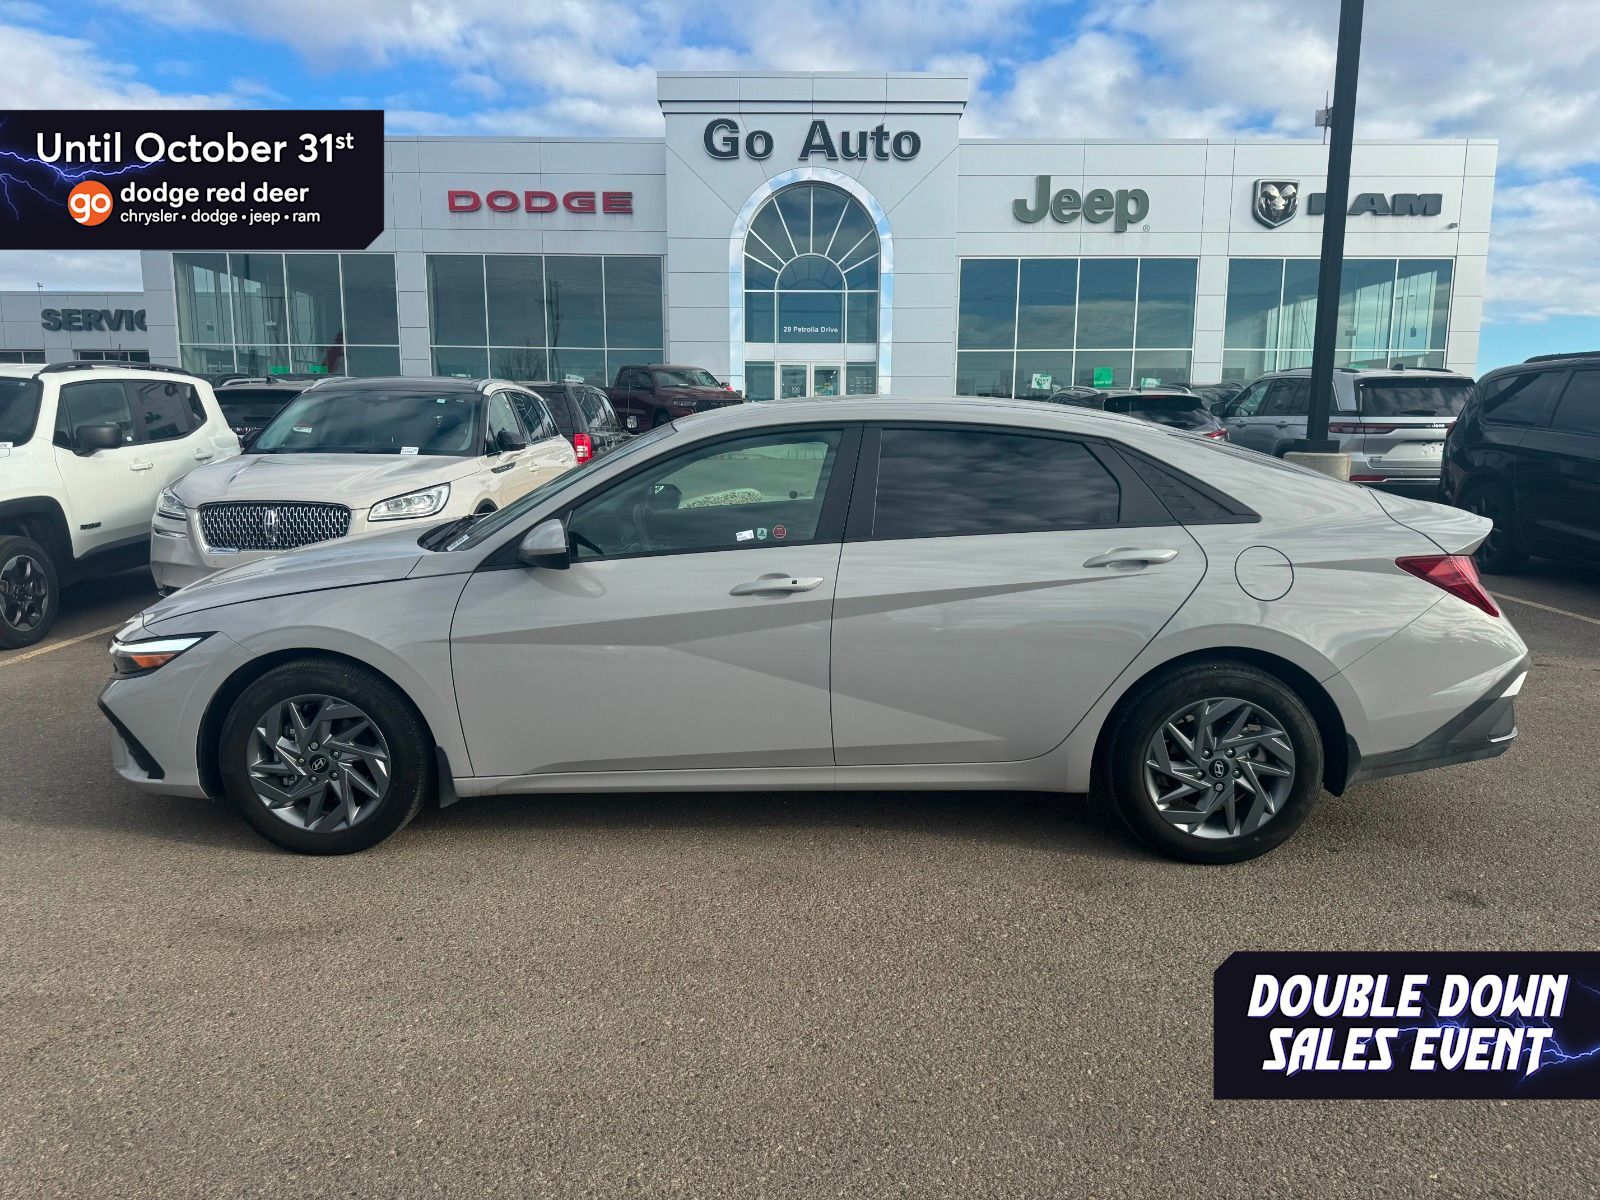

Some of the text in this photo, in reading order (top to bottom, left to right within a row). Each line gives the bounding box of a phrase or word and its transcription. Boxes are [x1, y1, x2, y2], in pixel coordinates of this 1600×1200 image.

[703, 118, 922, 161] Go Auto
[447, 190, 633, 214] DODGE
[1012, 174, 1150, 233] Jeep
